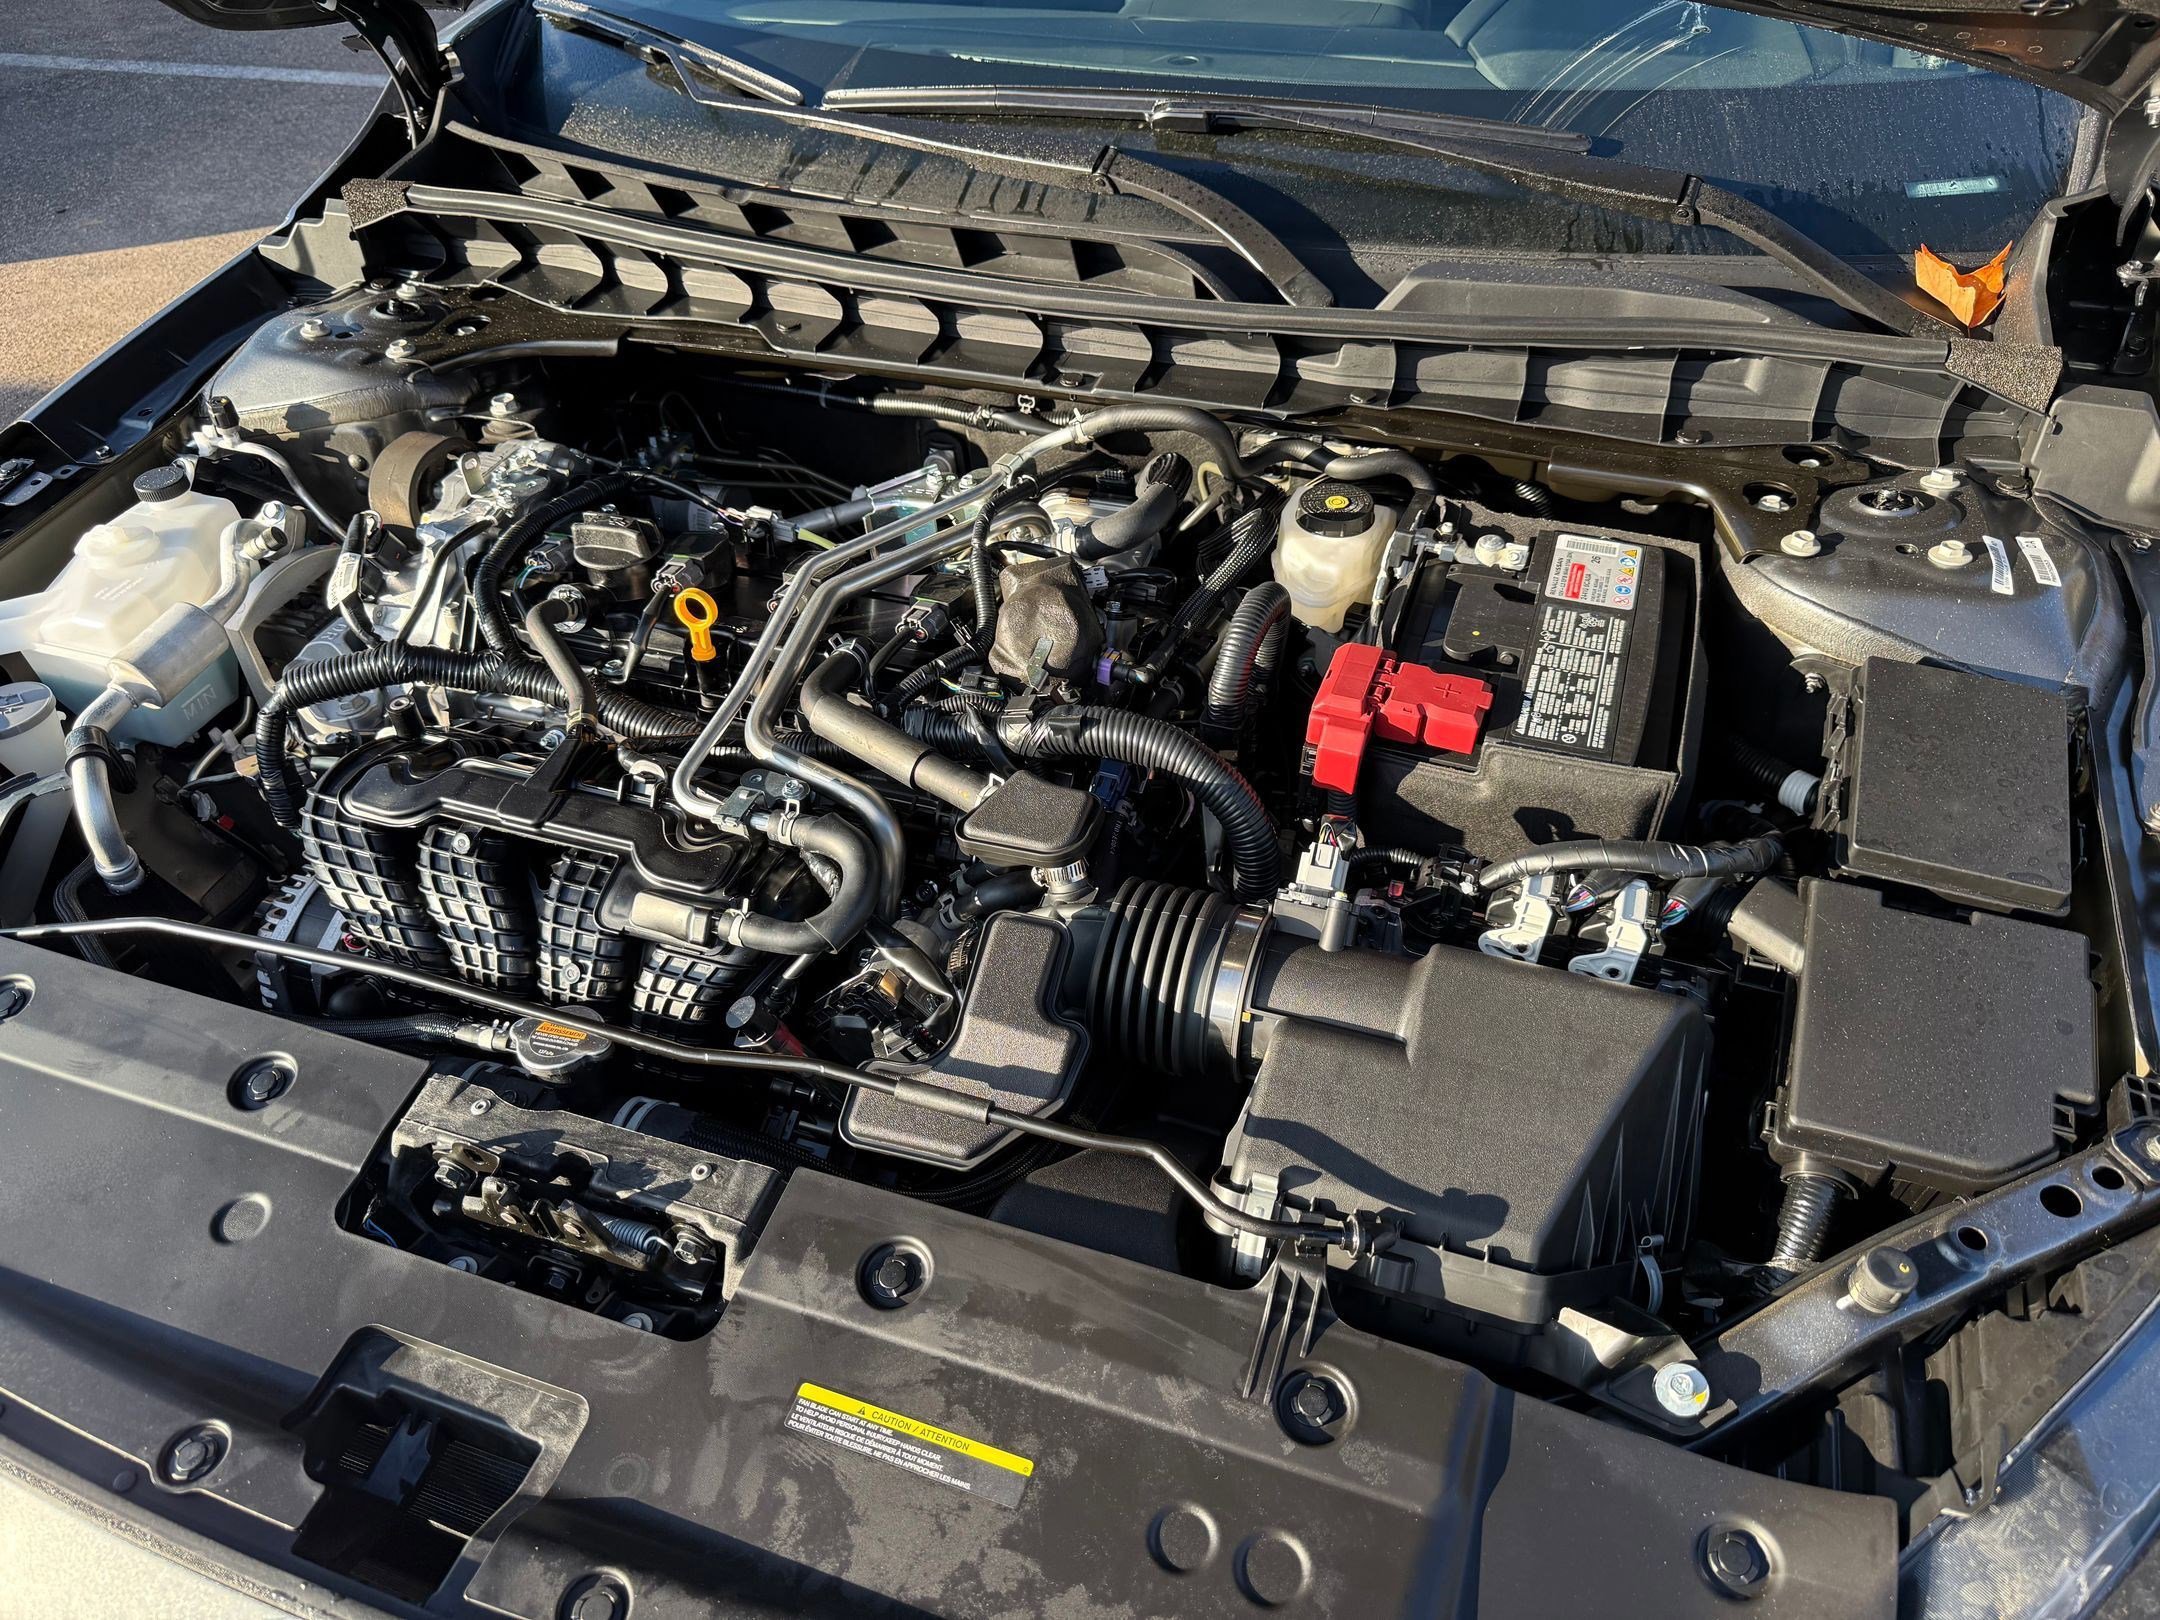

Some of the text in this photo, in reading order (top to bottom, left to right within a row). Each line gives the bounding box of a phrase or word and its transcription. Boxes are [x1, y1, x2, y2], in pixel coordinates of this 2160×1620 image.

[1553, 556, 1563, 576] NISSAN
[1590, 554, 1601, 564] 26
[183, 687, 217, 721] MIN
[795, 1405, 804, 1414] TO
[804, 1407, 819, 1418] HELP
[819, 1413, 836, 1424] AVOID
[836, 1418, 866, 1435] PERSONAL
[900, 1441, 921, 1454] HANDS
[799, 1398, 810, 1408] FAN
[810, 1402, 829, 1414] BLADE
[828, 1408, 841, 1418] CAN
[841, 1412, 859, 1424] START
[858, 1417, 867, 1426] AT
[867, 1420, 881, 1431] ANY
[872, 1412, 912, 1432] CAUTION
[920, 1428, 971, 1452] ATTENTION
[788, 1420, 805, 1431] POUR
[824, 1432, 843, 1444] TOUTE
[873, 1449, 882, 1458] NE
[882, 1451, 895, 1462] PAS
[895, 1456, 903, 1465] EN
[903, 1460, 940, 1478] APPROCHER
[940, 1473, 952, 1483] LES
[790, 1412, 800, 1420] LE
[799, 1415, 836, 1433] VENTILATEUR
[835, 1427, 857, 1440] RISQUE
[856, 1435, 866, 1443] DE
[902, 1451, 918, 1461] TOUT
